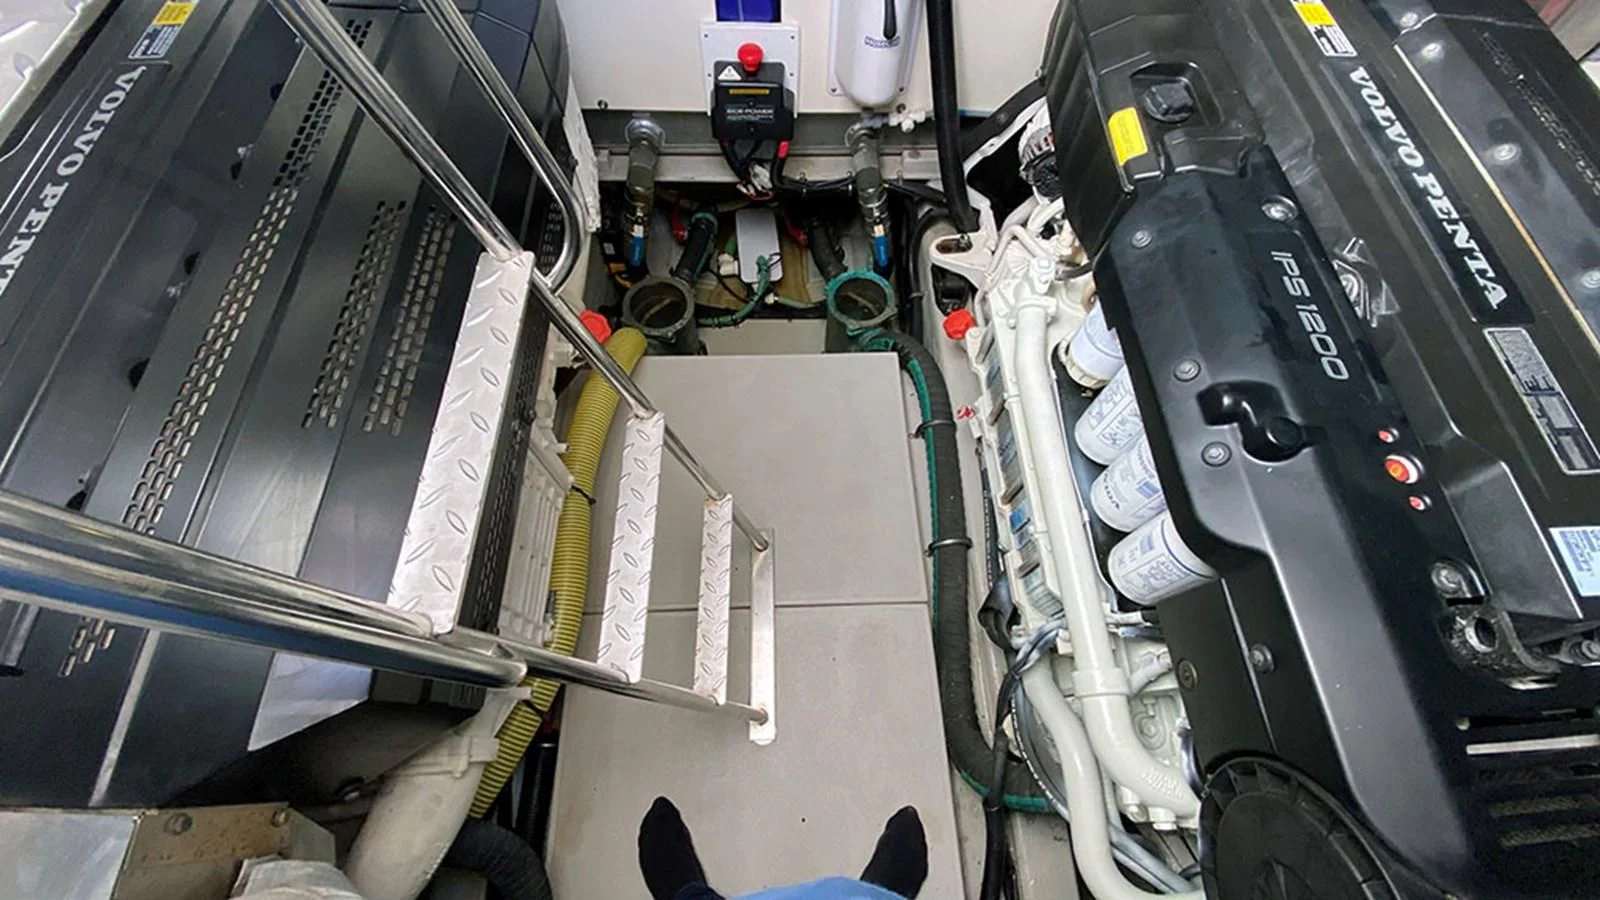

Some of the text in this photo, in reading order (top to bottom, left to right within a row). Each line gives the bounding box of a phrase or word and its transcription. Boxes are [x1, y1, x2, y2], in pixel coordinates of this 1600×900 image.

[57, 65, 146, 176] VOLVO
[1349, 66, 1509, 310] VOLVO PENTA
[1270, 250, 1350, 382] IPS 1200
